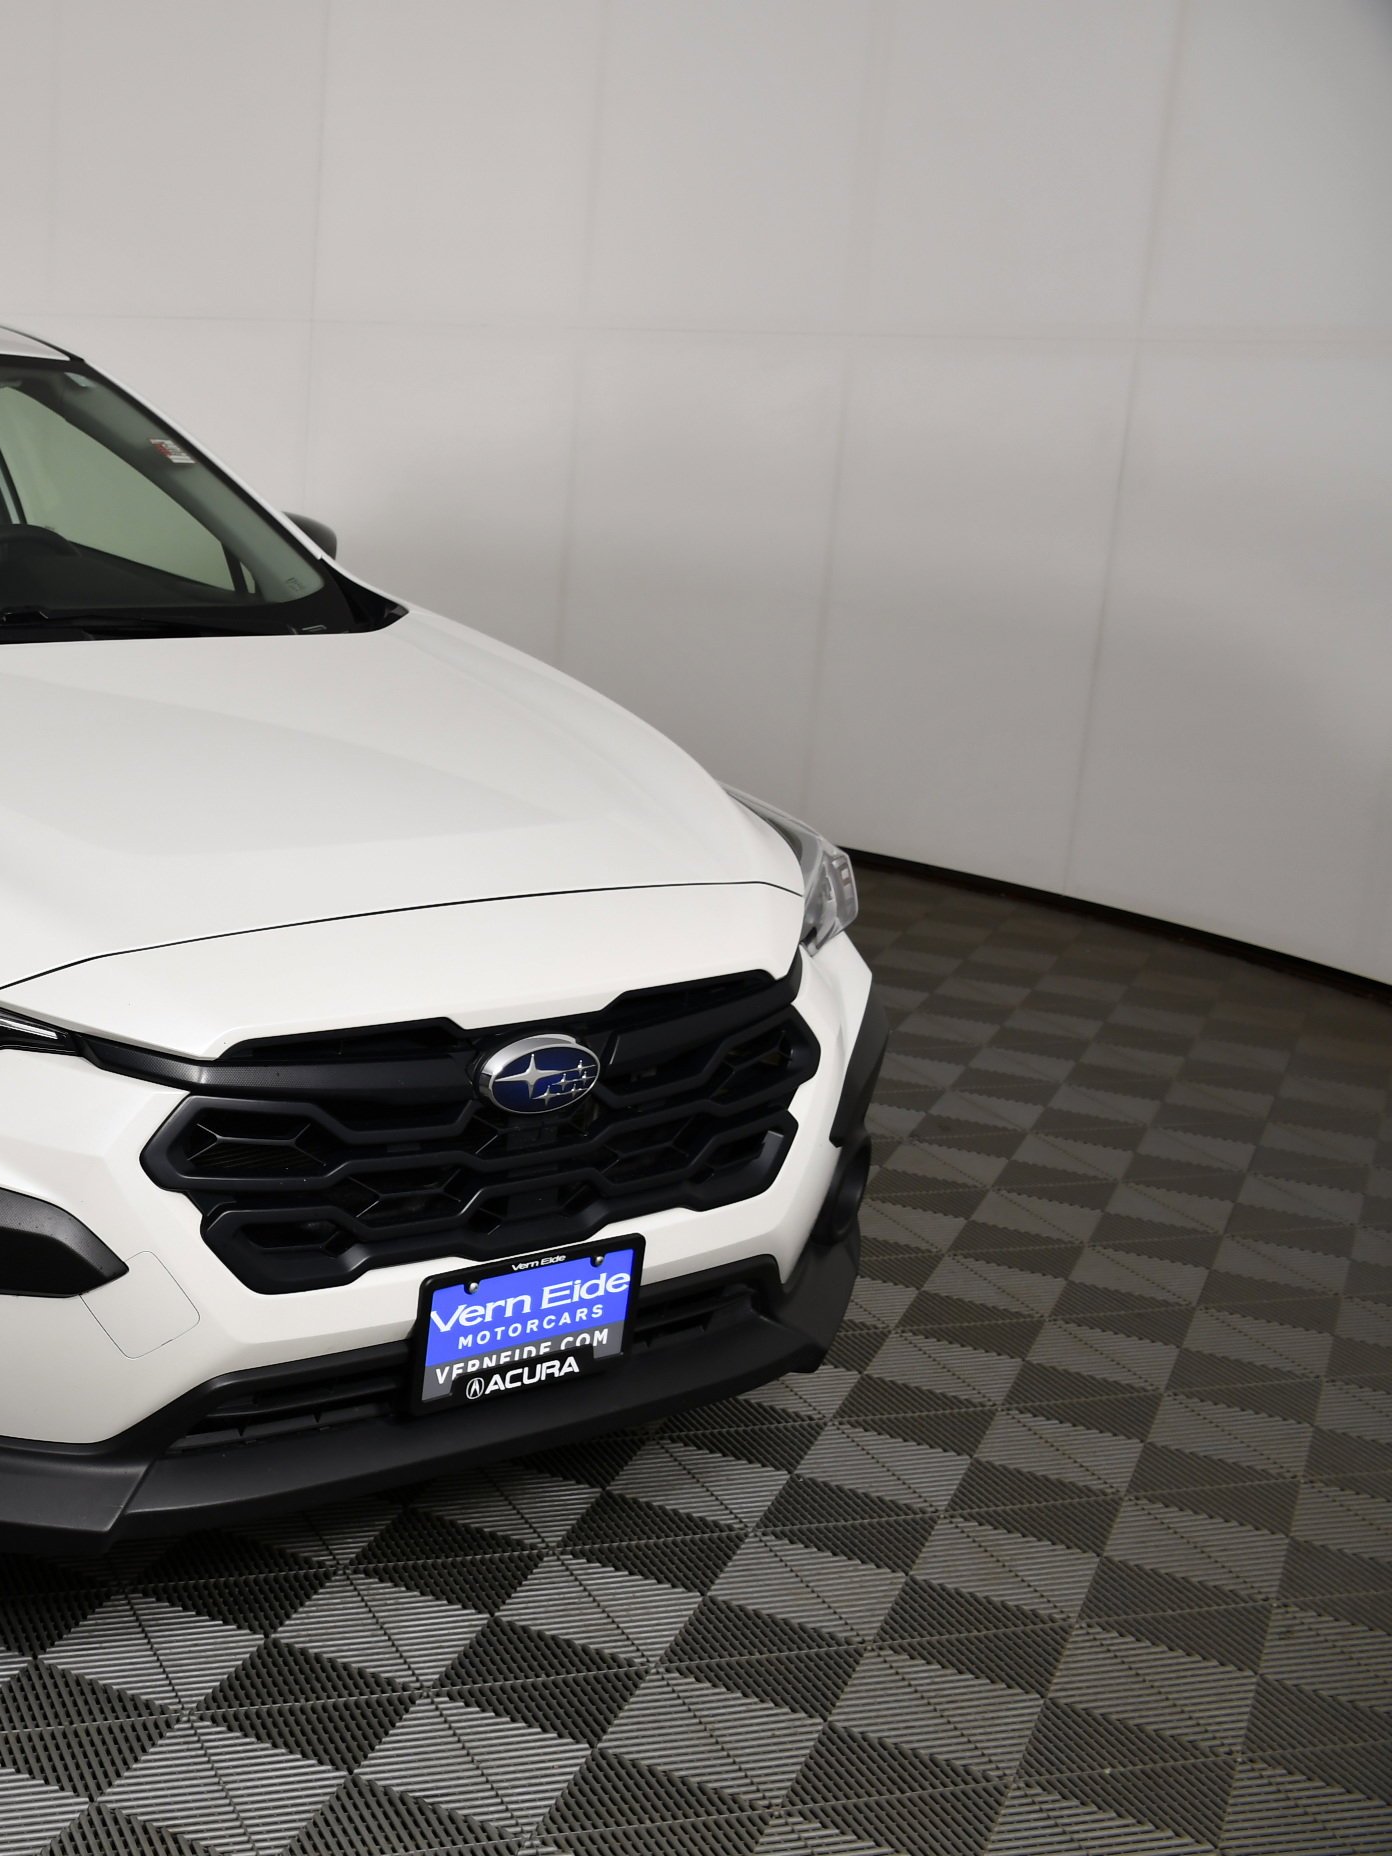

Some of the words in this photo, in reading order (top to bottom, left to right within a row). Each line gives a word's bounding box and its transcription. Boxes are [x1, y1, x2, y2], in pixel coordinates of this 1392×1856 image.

[511, 1261, 539, 1271] Vern
[540, 1255, 566, 1265] Eide
[430, 1291, 532, 1333] Vern
[540, 1272, 631, 1310] Eide
[457, 1304, 604, 1350] MOTORCARS
[435, 1328, 609, 1384] VERNEIDECOM
[484, 1356, 580, 1395] ACURA
